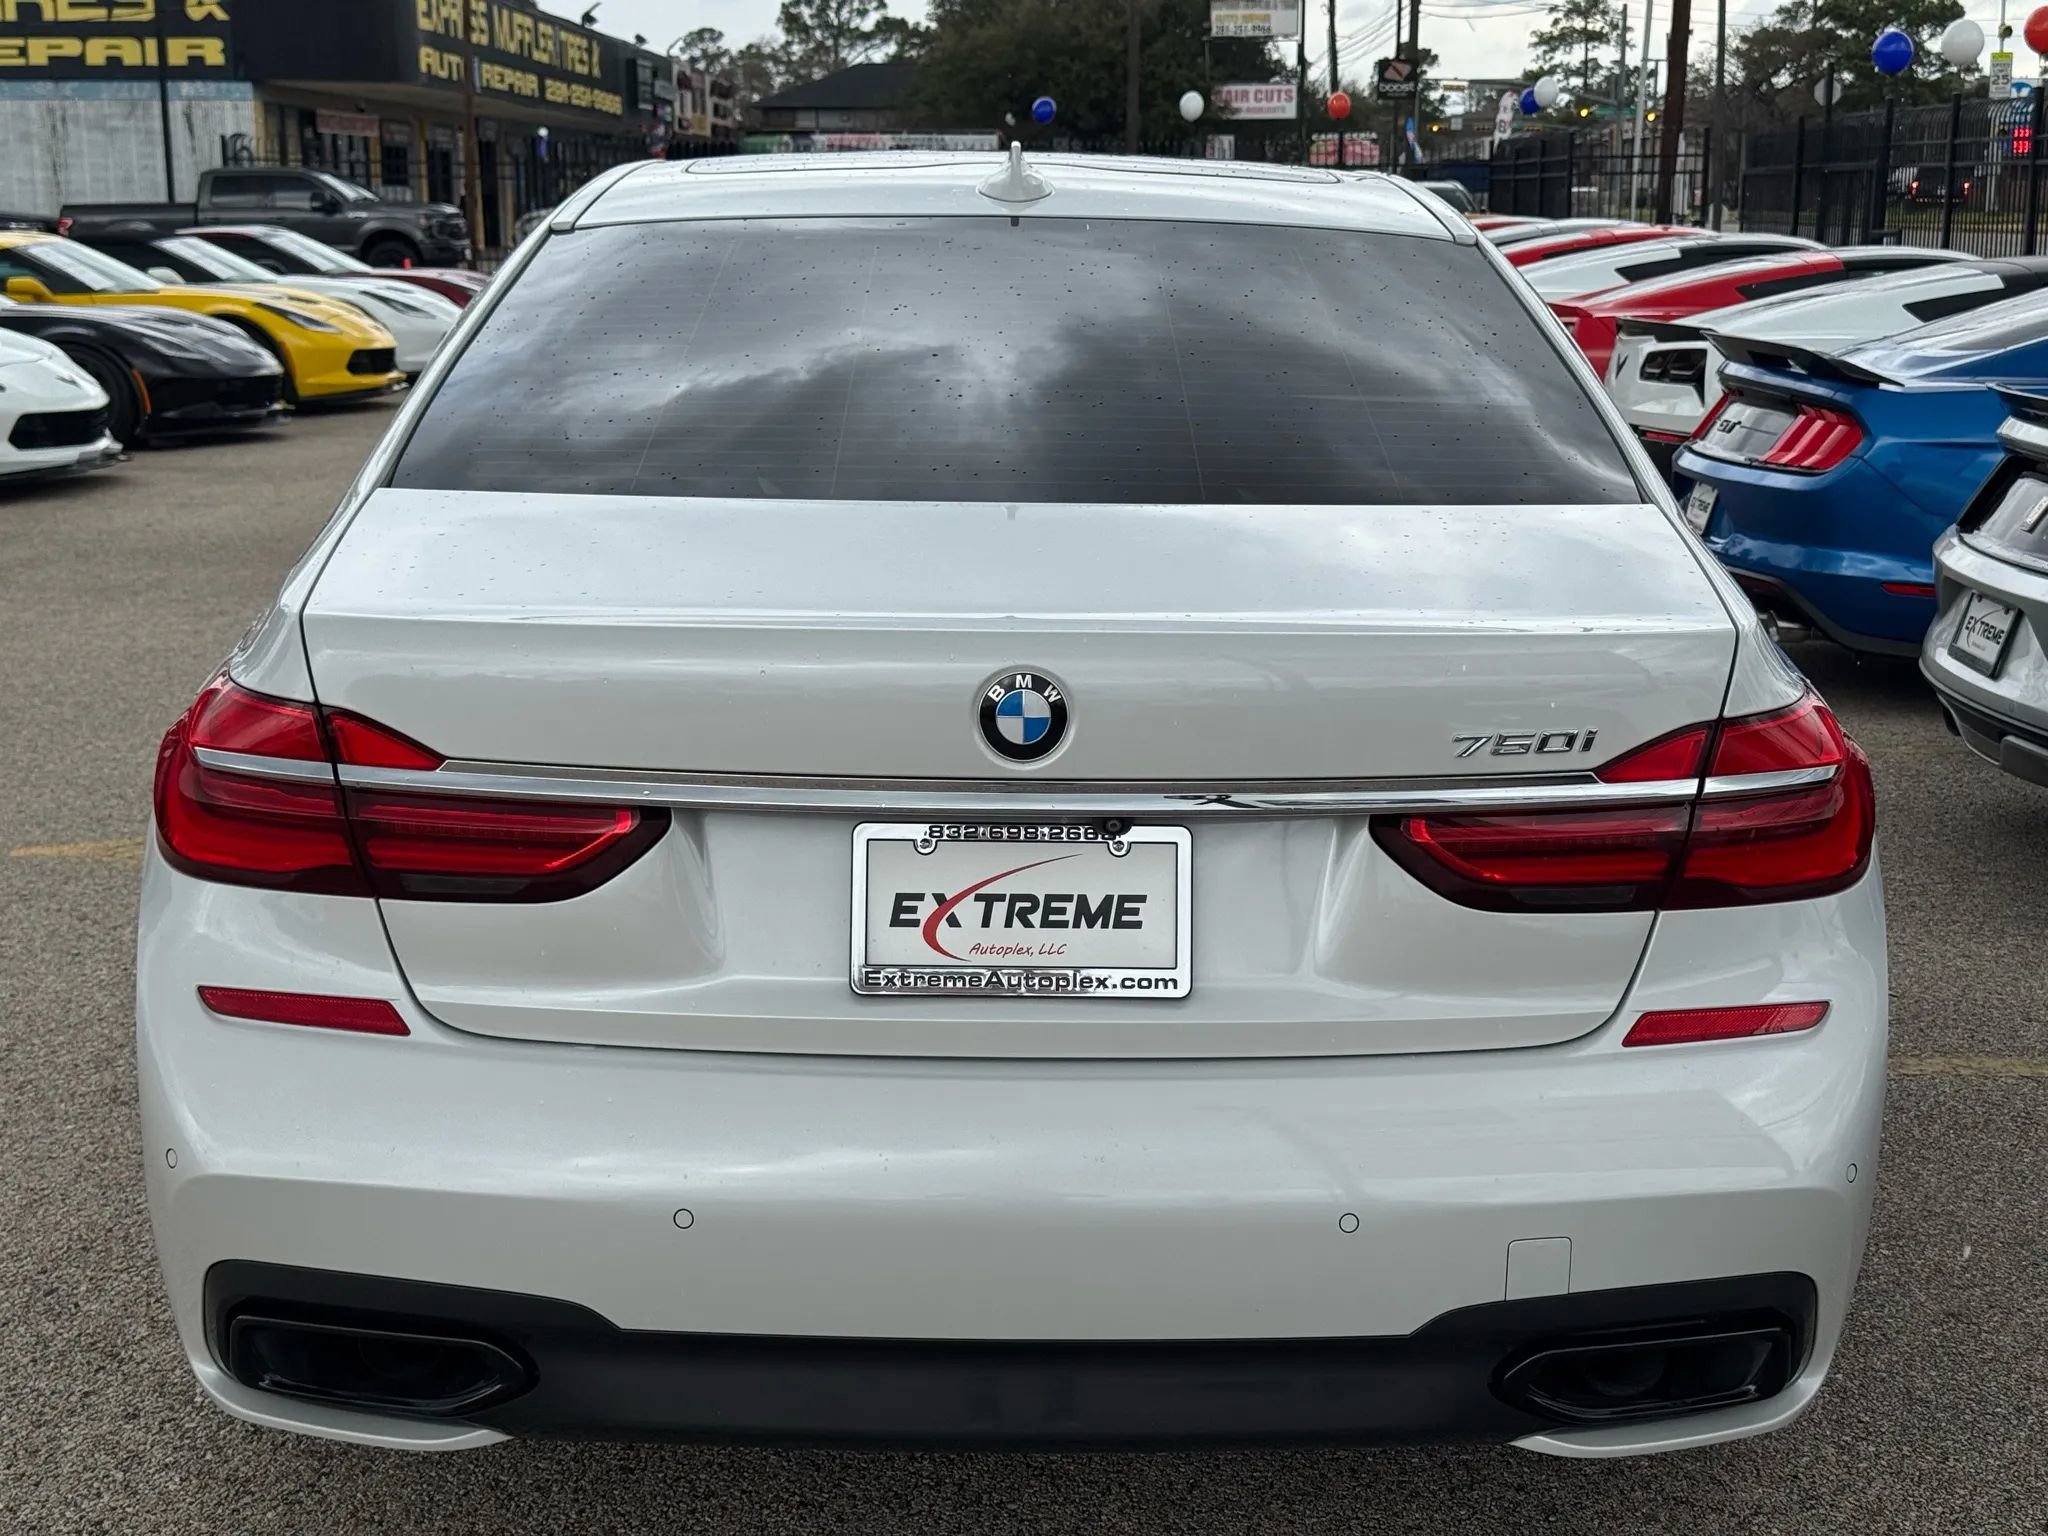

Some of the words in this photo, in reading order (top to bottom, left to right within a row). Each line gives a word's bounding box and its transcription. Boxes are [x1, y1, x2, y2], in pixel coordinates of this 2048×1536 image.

[481, 62, 540, 98] REPAIR
[1379, 81, 1415, 92] boost
[1991, 74, 2010, 86] 25
[1253, 88, 1294, 103] CUTS
[1965, 615, 2005, 646] EXTREME
[987, 674, 1062, 703] BMW
[1452, 728, 1599, 758] 750i
[888, 892, 1148, 930] EXTREME
[968, 942, 1034, 958] Autoplex,
[1038, 942, 1068, 955] LLC
[864, 970, 1178, 991] ExtremeAutoplex.com
